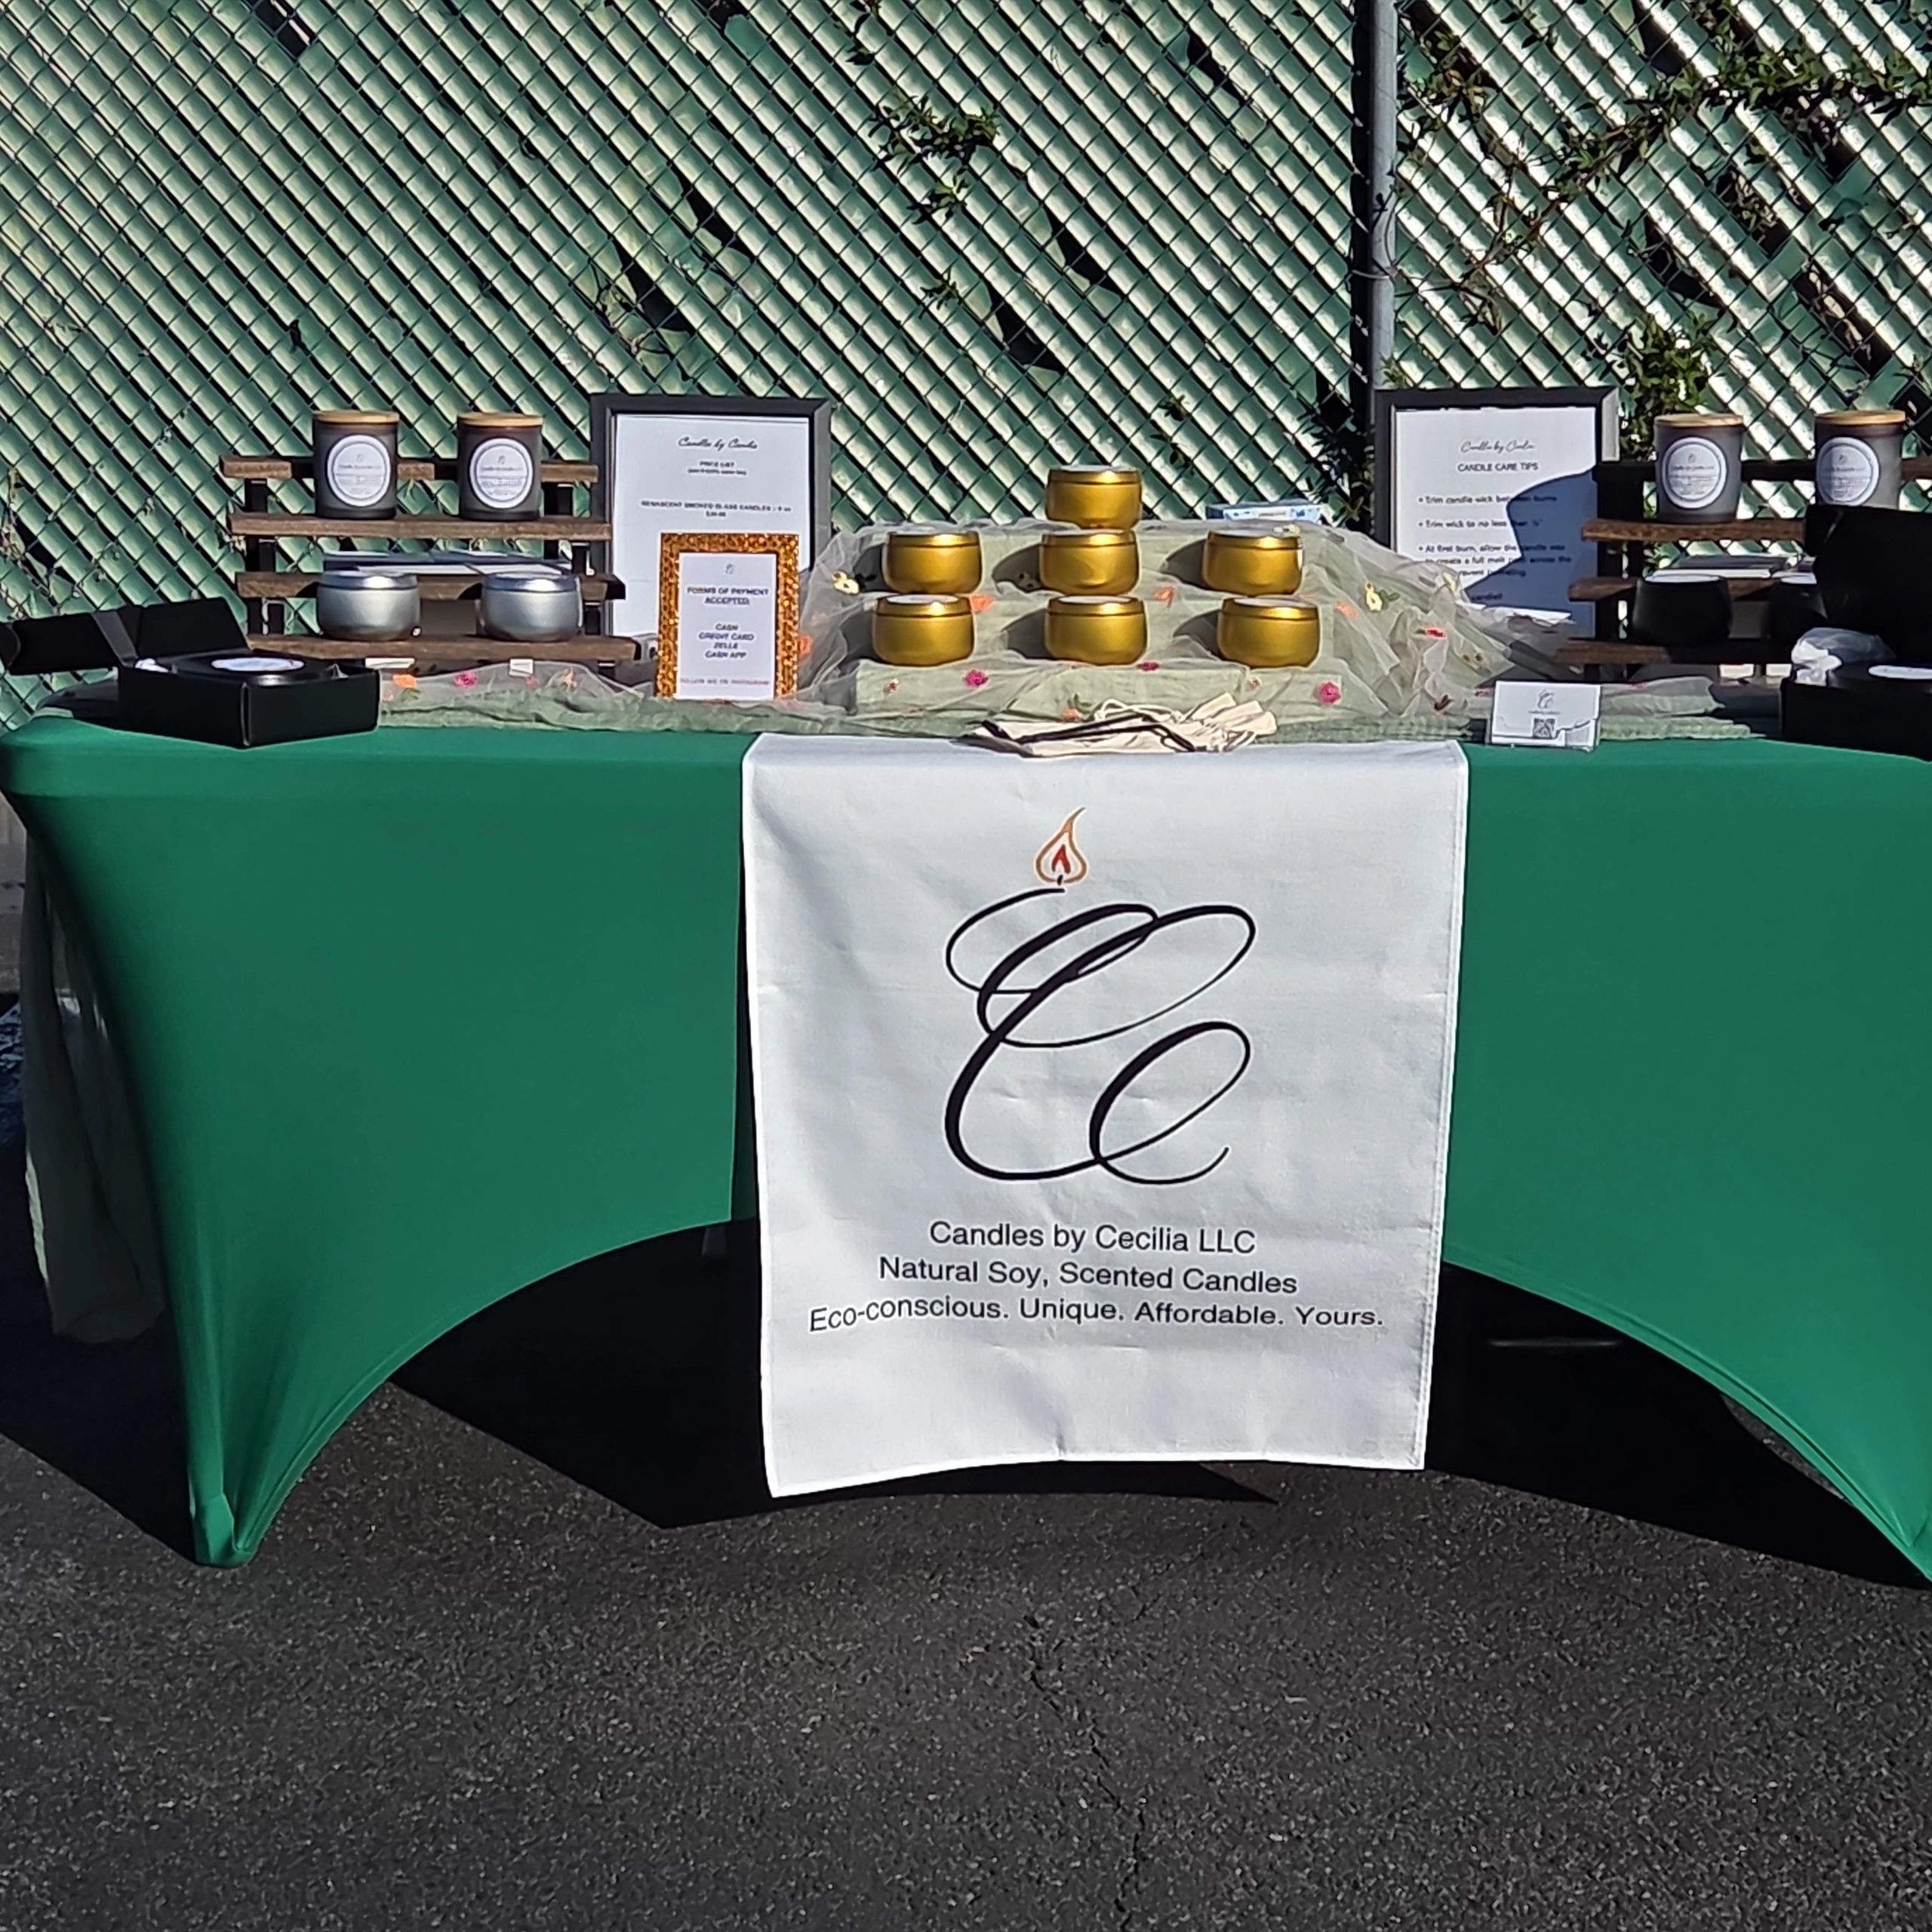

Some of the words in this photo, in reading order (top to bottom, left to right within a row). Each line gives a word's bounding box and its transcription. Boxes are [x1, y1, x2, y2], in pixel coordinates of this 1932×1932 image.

[1457, 463, 1494, 472] CANDLE
[1494, 463, 1517, 472] CARE
[1520, 462, 1539, 471] TIPS
[1445, 495, 1472, 503] candle
[1491, 519, 1507, 528] less
[1504, 543, 1517, 552] the
[1472, 556, 1484, 565] full
[930, 1220, 1044, 1247] Candles
[1054, 1224, 1086, 1254] by
[1096, 1224, 1189, 1252] Cecilia
[1199, 1229, 1256, 1254] LLC
[880, 1257, 978, 1282] Natural
[988, 1261, 1048, 1289] Soy,
[1060, 1262, 1173, 1289] Scented
[1183, 1268, 1298, 1294] Candles
[810, 1295, 1009, 1332] Eco-conscious.
[1020, 1297, 1124, 1325] Unique.
[1134, 1301, 1284, 1325] Affordable.
[1295, 1306, 1383, 1325] Yours.
